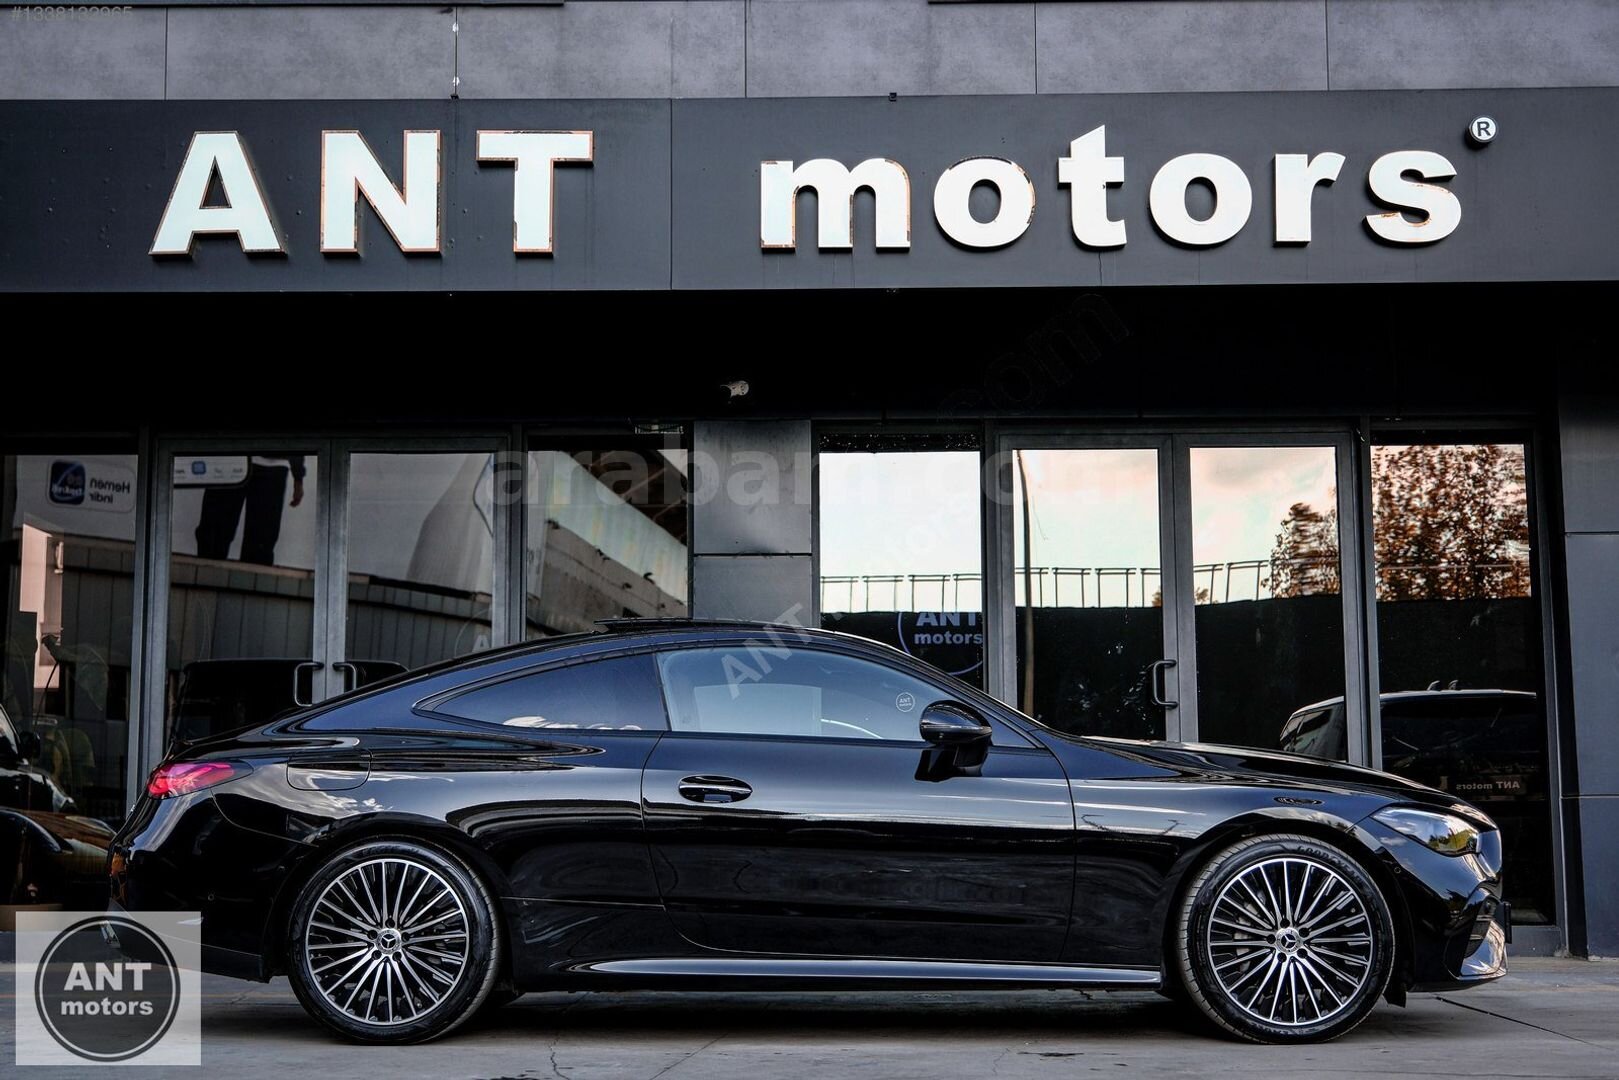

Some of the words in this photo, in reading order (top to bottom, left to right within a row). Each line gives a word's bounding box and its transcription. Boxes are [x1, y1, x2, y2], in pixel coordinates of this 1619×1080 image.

[148, 129, 595, 257] ANT
[760, 124, 1463, 250] motors
[913, 630, 983, 645] motors
